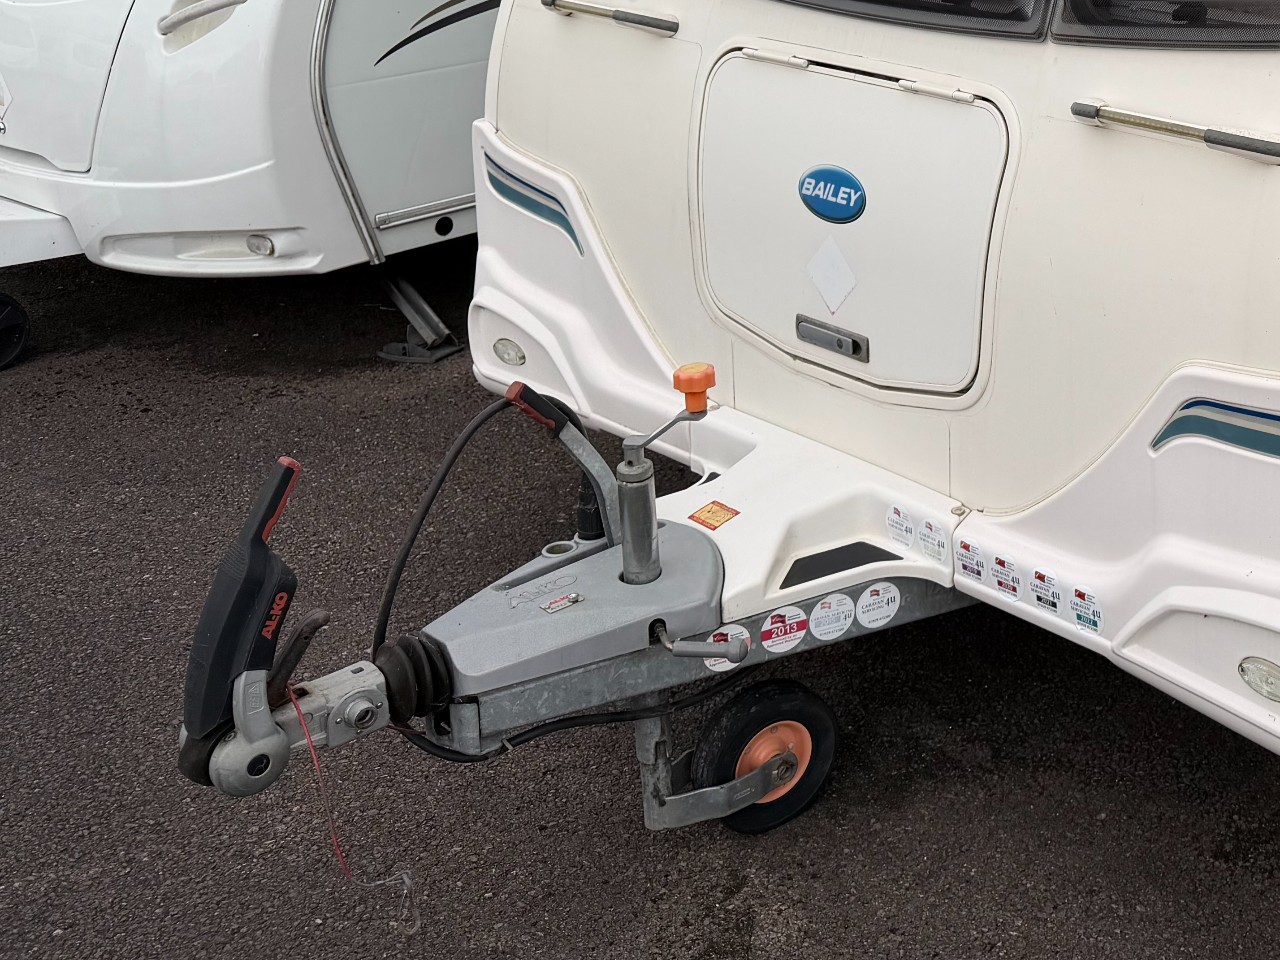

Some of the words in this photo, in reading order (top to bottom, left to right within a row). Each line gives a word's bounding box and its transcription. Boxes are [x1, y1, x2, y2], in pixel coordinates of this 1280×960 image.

[801, 177, 863, 208] BAILEY
[261, 591, 289, 640] AL-KO
[771, 622, 798, 639] 2013
